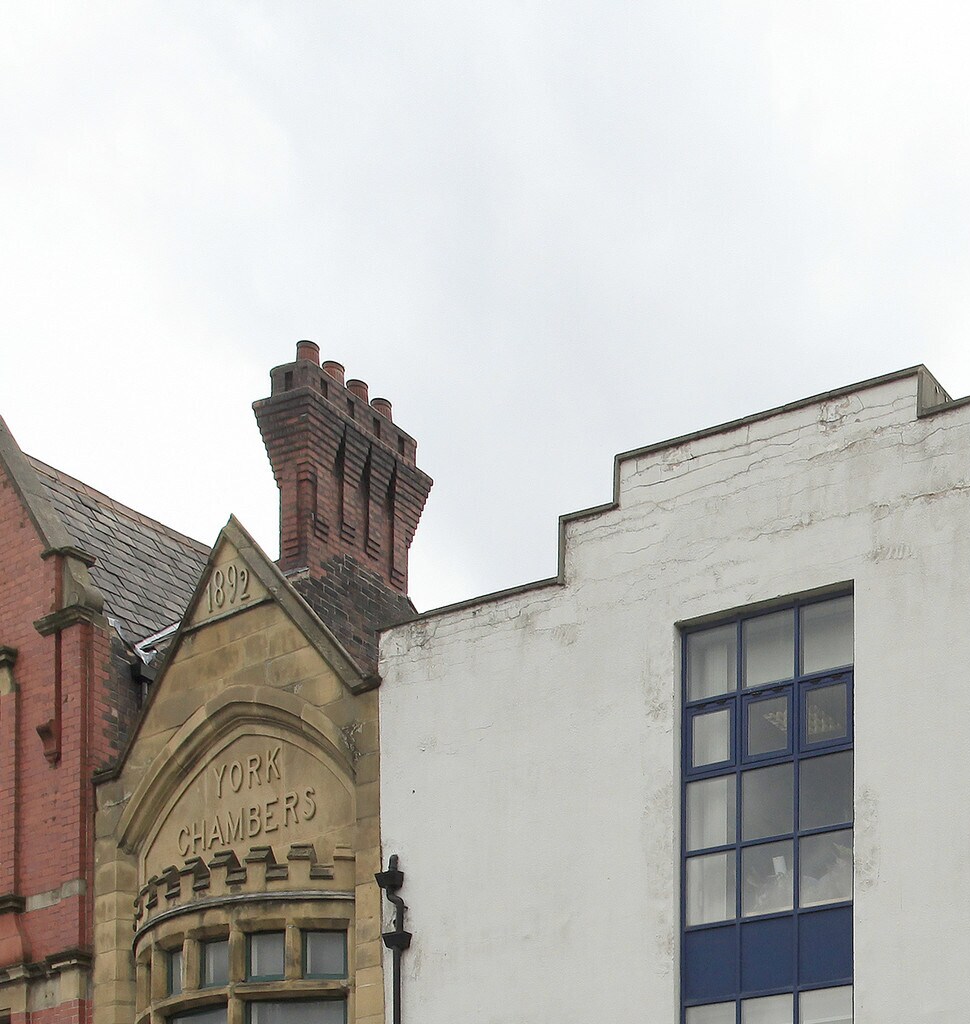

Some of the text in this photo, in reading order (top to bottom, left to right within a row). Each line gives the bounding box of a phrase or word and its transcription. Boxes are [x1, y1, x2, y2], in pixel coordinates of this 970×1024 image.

[206, 564, 250, 613] 1892
[213, 747, 281, 799] YORK
[177, 787, 317, 857] CHAMBERS
